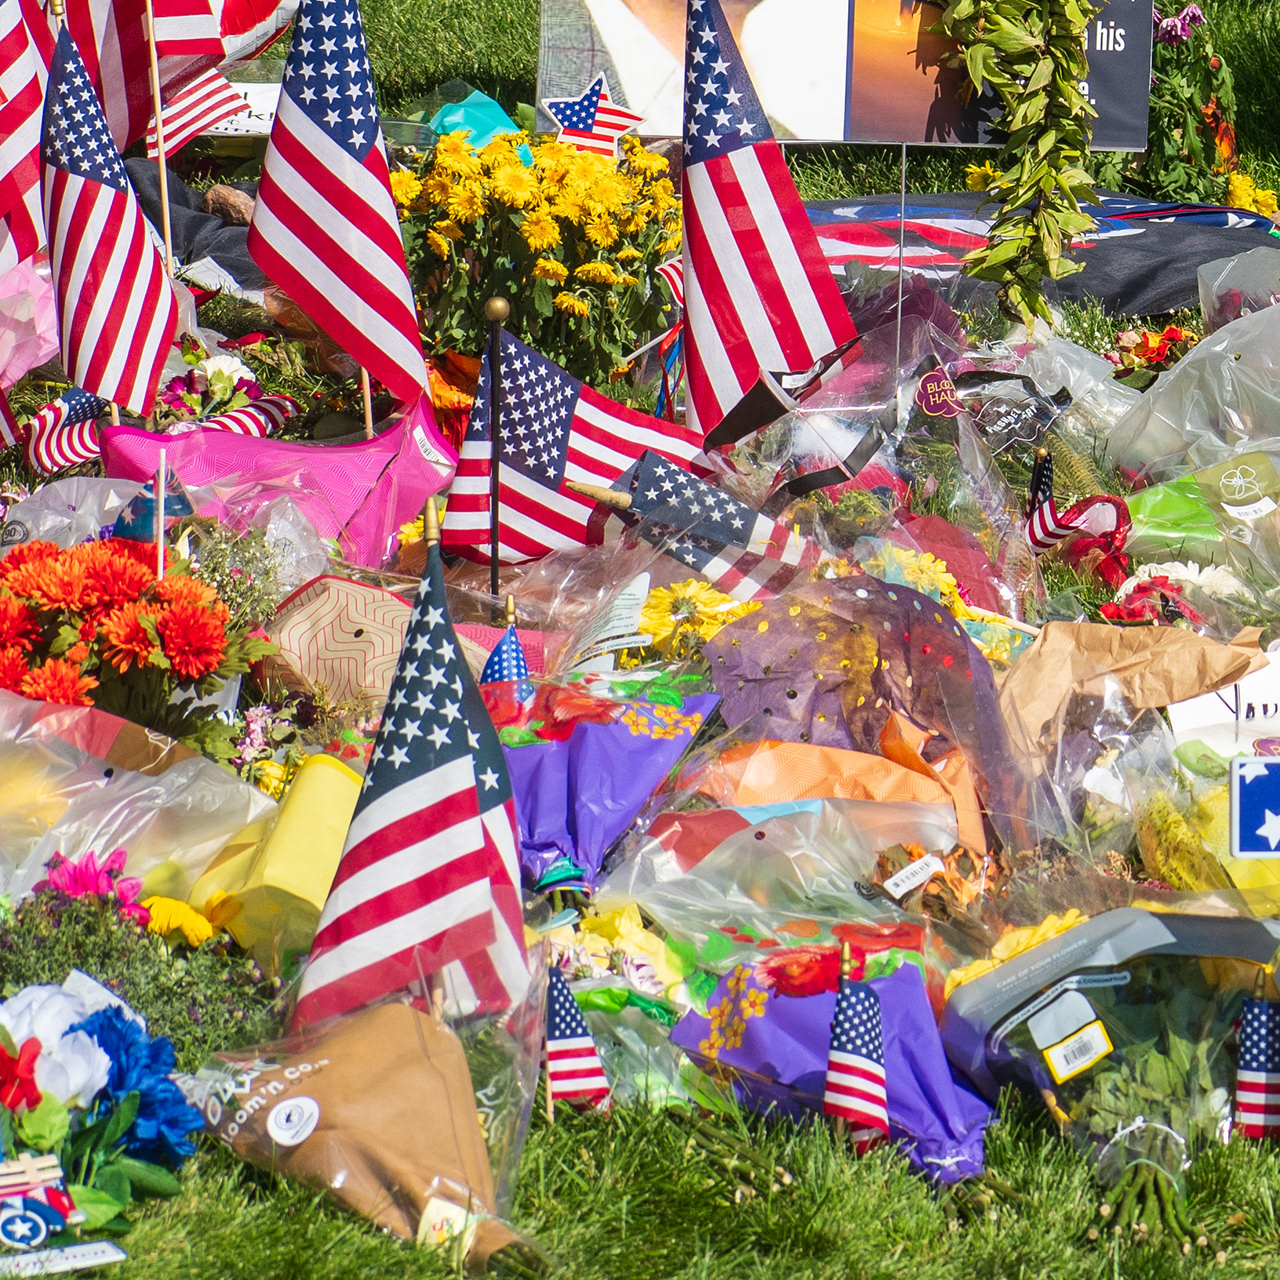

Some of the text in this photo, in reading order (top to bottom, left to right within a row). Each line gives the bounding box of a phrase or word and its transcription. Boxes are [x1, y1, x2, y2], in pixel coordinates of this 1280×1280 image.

[1095, 21, 1126, 52] his
[929, 391, 956, 406] HAU
[221, 1079, 286, 1144] loom'n
